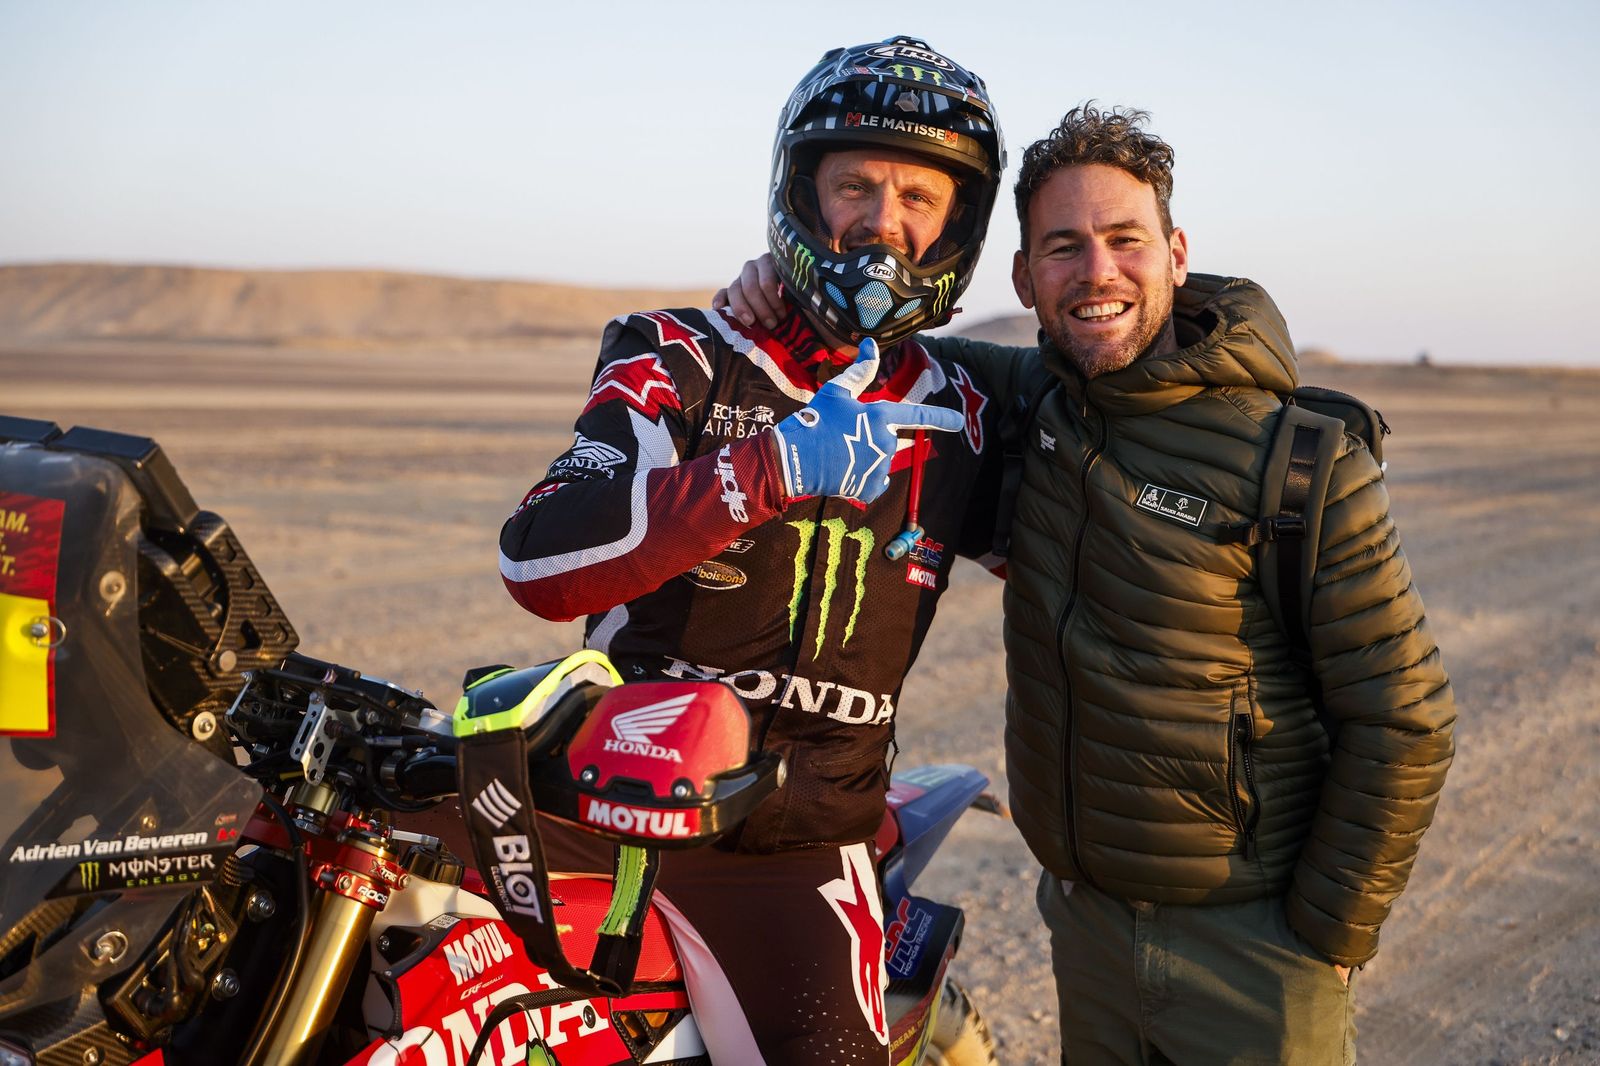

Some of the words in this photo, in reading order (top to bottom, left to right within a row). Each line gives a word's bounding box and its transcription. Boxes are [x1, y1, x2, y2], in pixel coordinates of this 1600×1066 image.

[548, 457, 615, 480] ONDA
[690, 565, 745, 584] diboissons
[908, 567, 937, 588] MOTUL
[603, 738, 683, 763] HONDA
[587, 799, 690, 837] MOTUL
[10, 842, 80, 863] Adrien
[83, 838, 124, 855] Van
[124, 831, 208, 852] Beveren
[126, 870, 201, 888] ENERGY
[492, 834, 544, 924] BLOT
[443, 922, 514, 987] MOTUL
